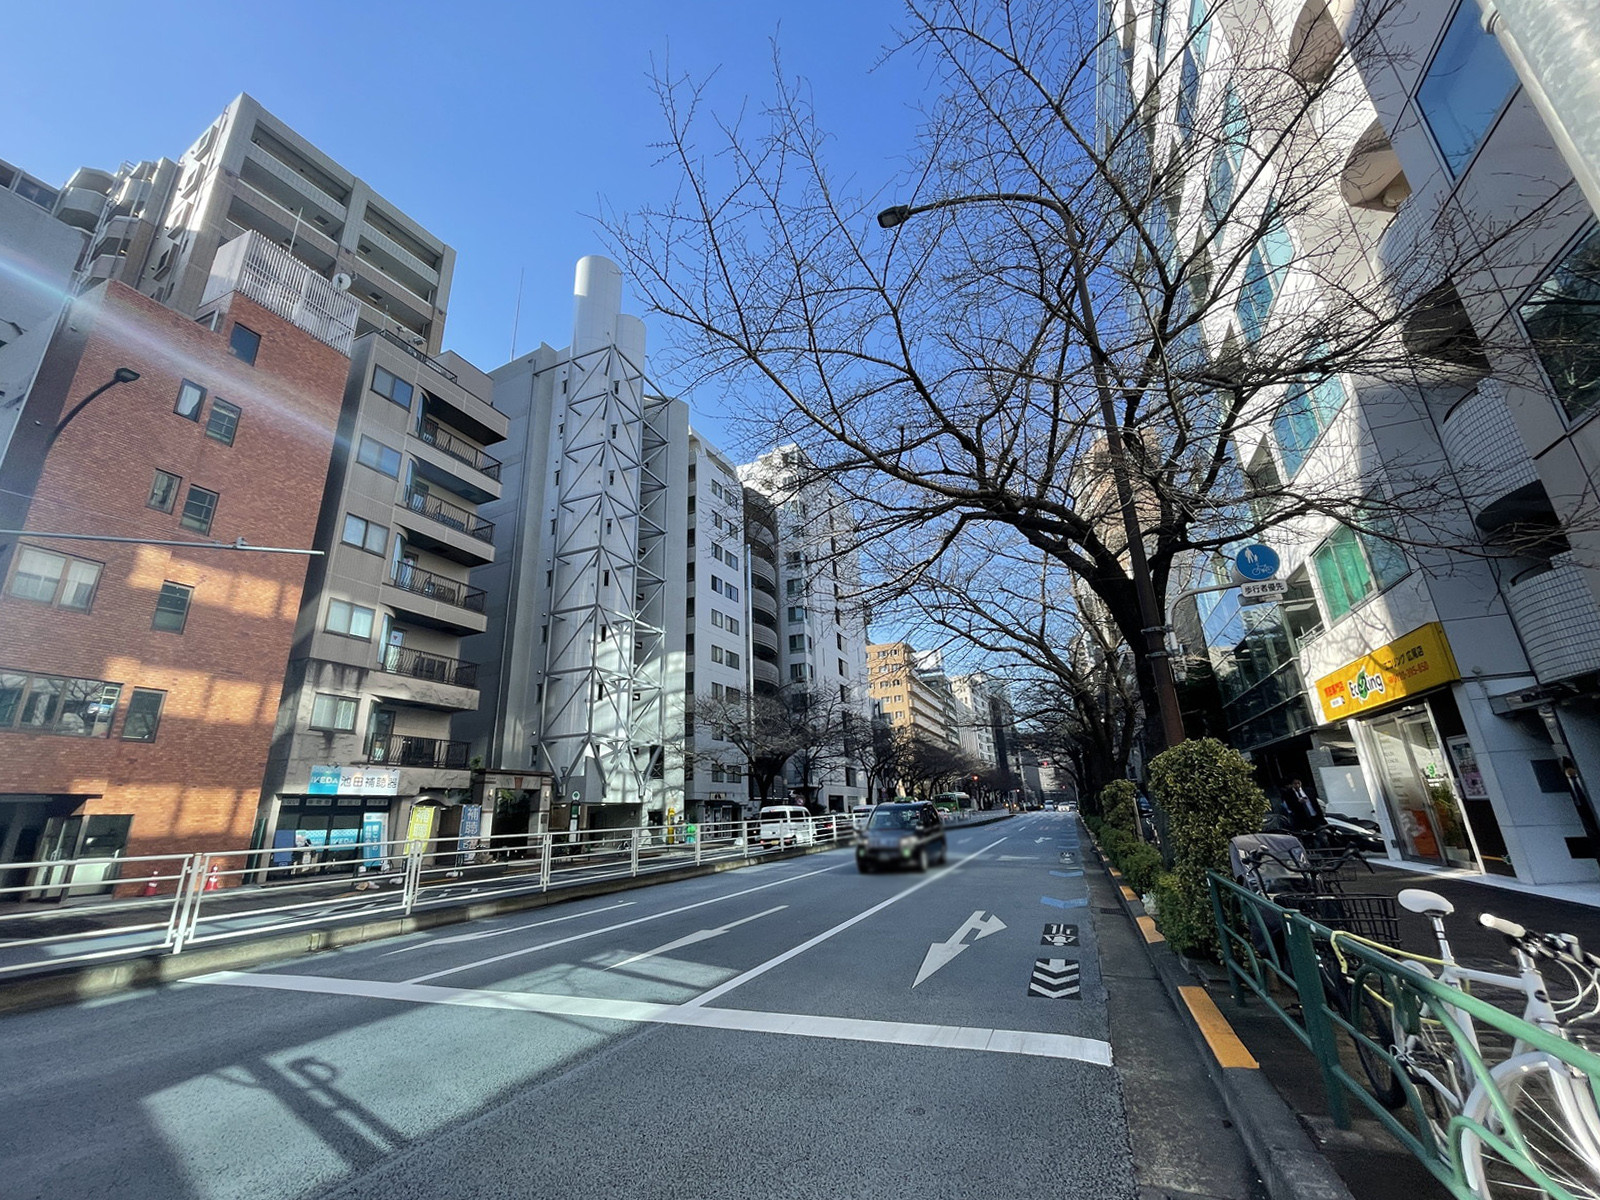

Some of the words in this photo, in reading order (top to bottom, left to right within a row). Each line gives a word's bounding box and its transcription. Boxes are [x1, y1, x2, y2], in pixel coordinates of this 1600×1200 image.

[1244, 582, 1285, 595] 歩行者優先
[311, 776, 338, 784] IKEDA
[340, 775, 398, 789] 池田補聴器
